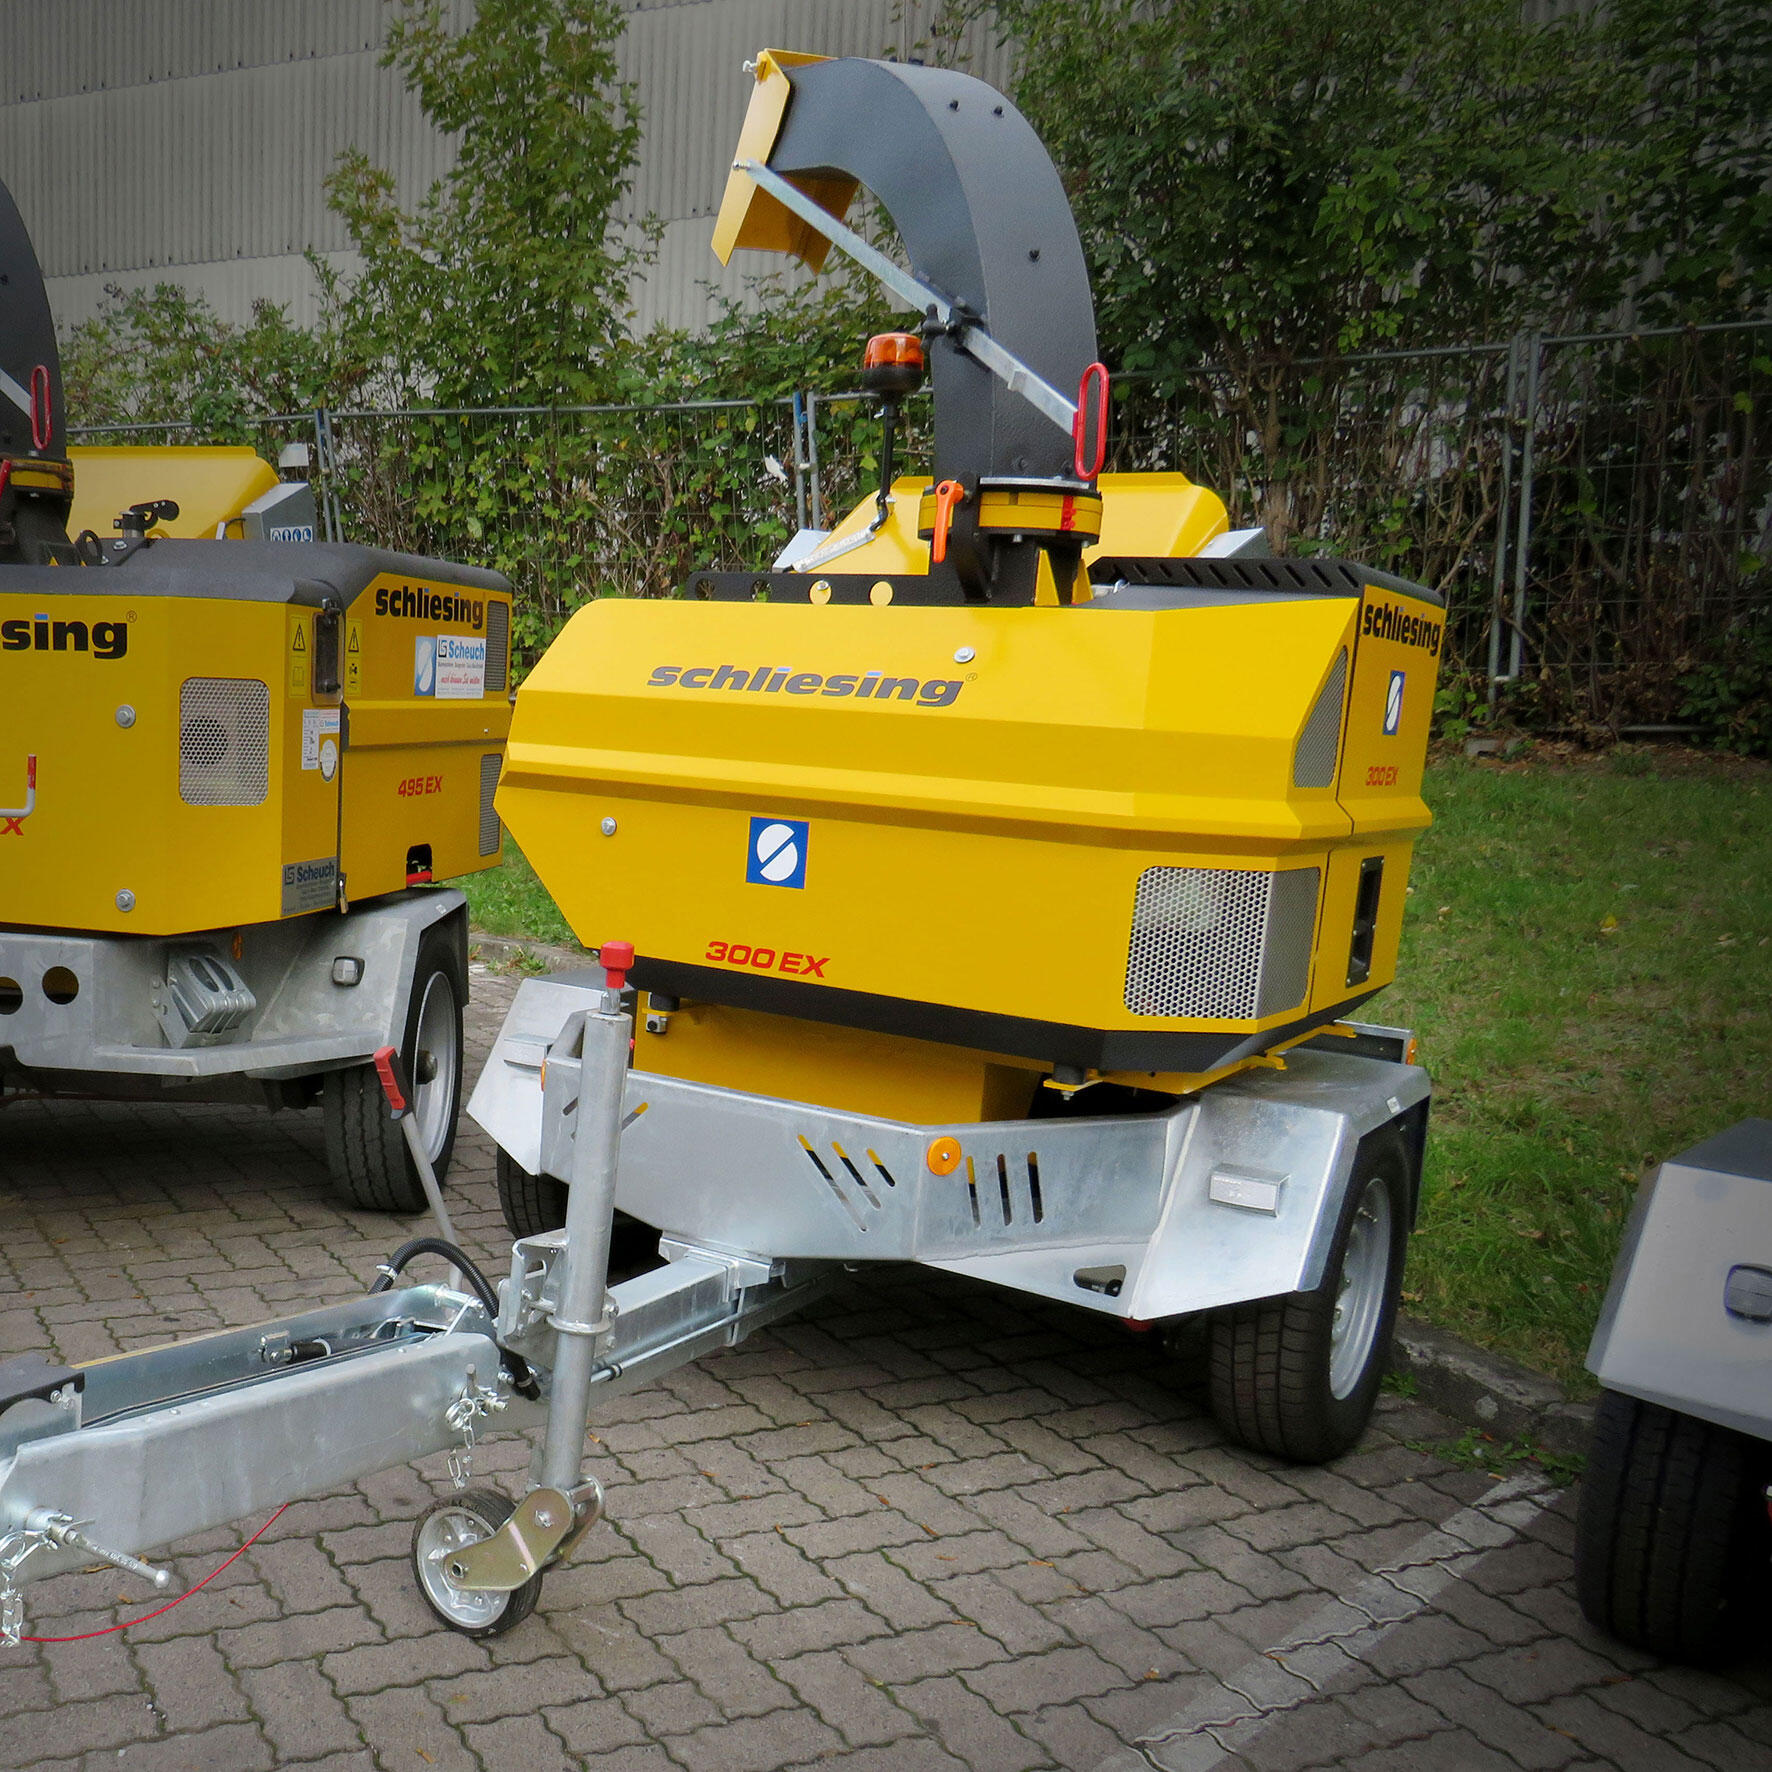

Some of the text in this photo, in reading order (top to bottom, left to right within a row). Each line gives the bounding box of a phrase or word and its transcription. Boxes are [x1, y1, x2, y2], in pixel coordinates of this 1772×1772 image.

[375, 585, 483, 630] schliesing
[1363, 603, 1441, 657] schliesing
[448, 640, 485, 660] Scheuch
[647, 664, 965, 707] schliesing
[398, 775, 443, 798] 495 EX
[297, 861, 335, 882] Scheuch
[705, 941, 831, 978] 300 EX
